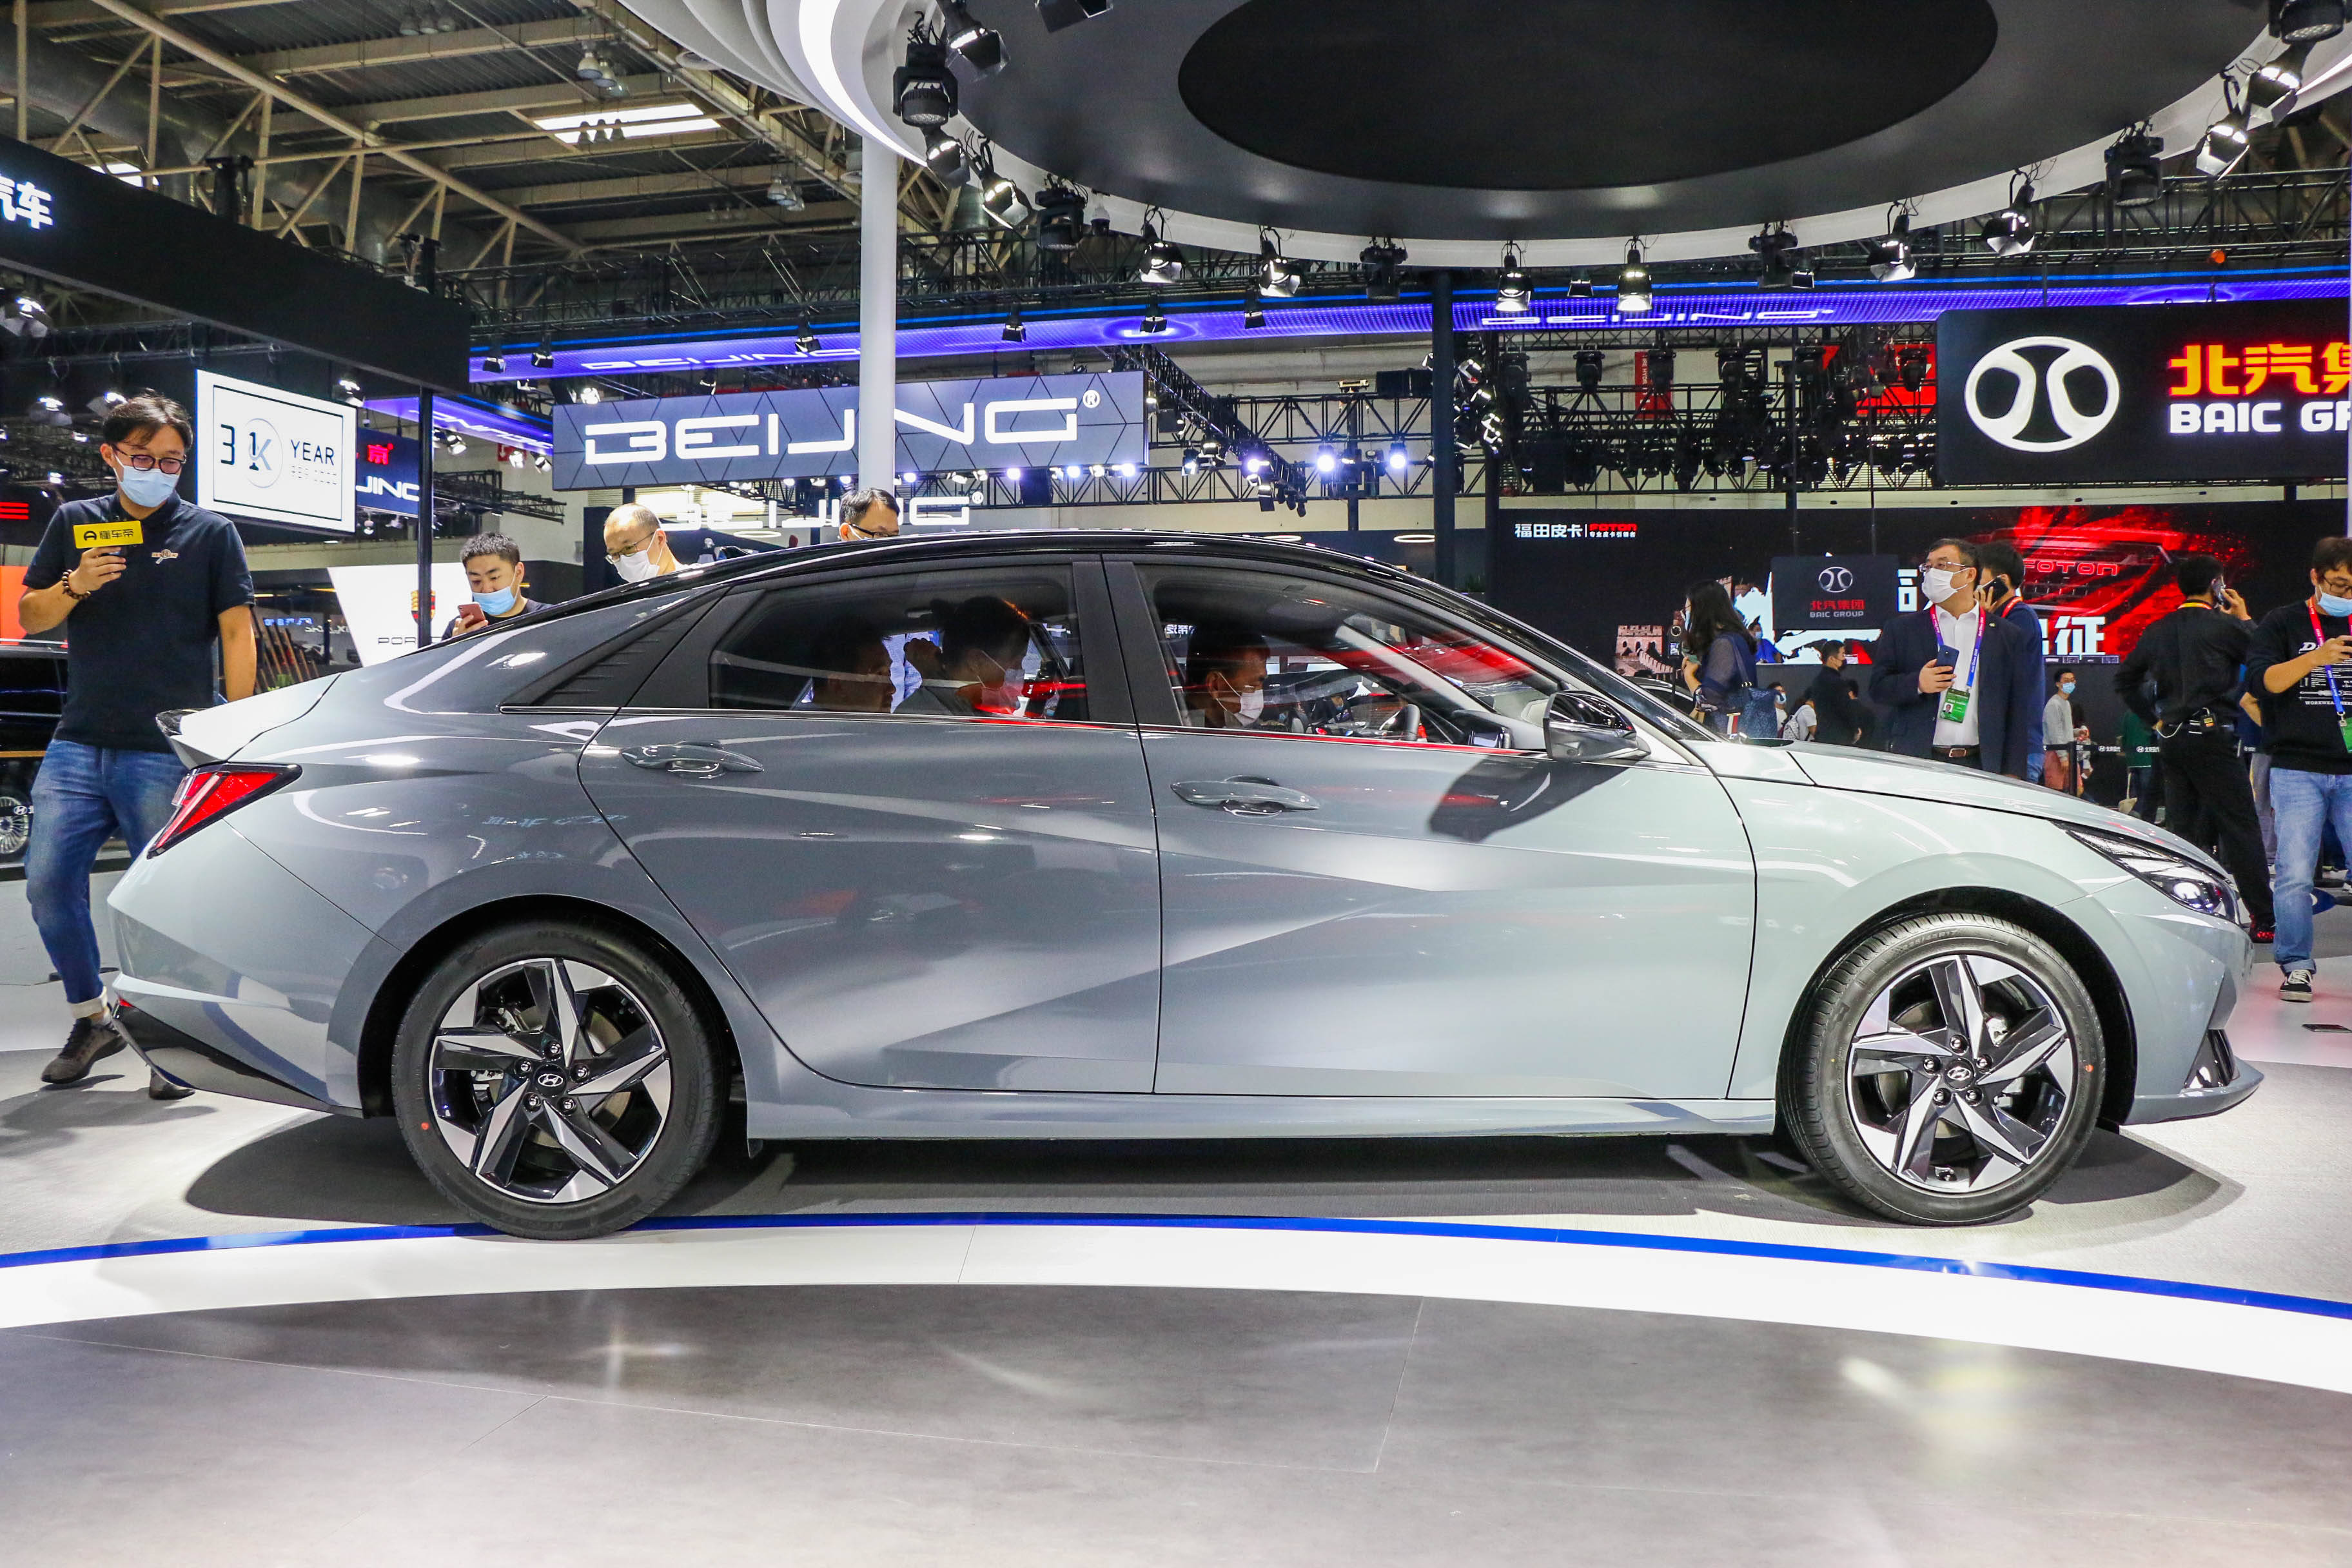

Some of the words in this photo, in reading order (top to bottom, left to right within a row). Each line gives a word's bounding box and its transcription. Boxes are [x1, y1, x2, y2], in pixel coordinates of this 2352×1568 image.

[585, 397, 1078, 465] BEIJNG
[2170, 402, 2282, 433] BAIC
[291, 439, 335, 466] YEAR
[1515, 524, 1583, 538] 福田皮卡
[1810, 600, 1865, 611] 北汽集团
